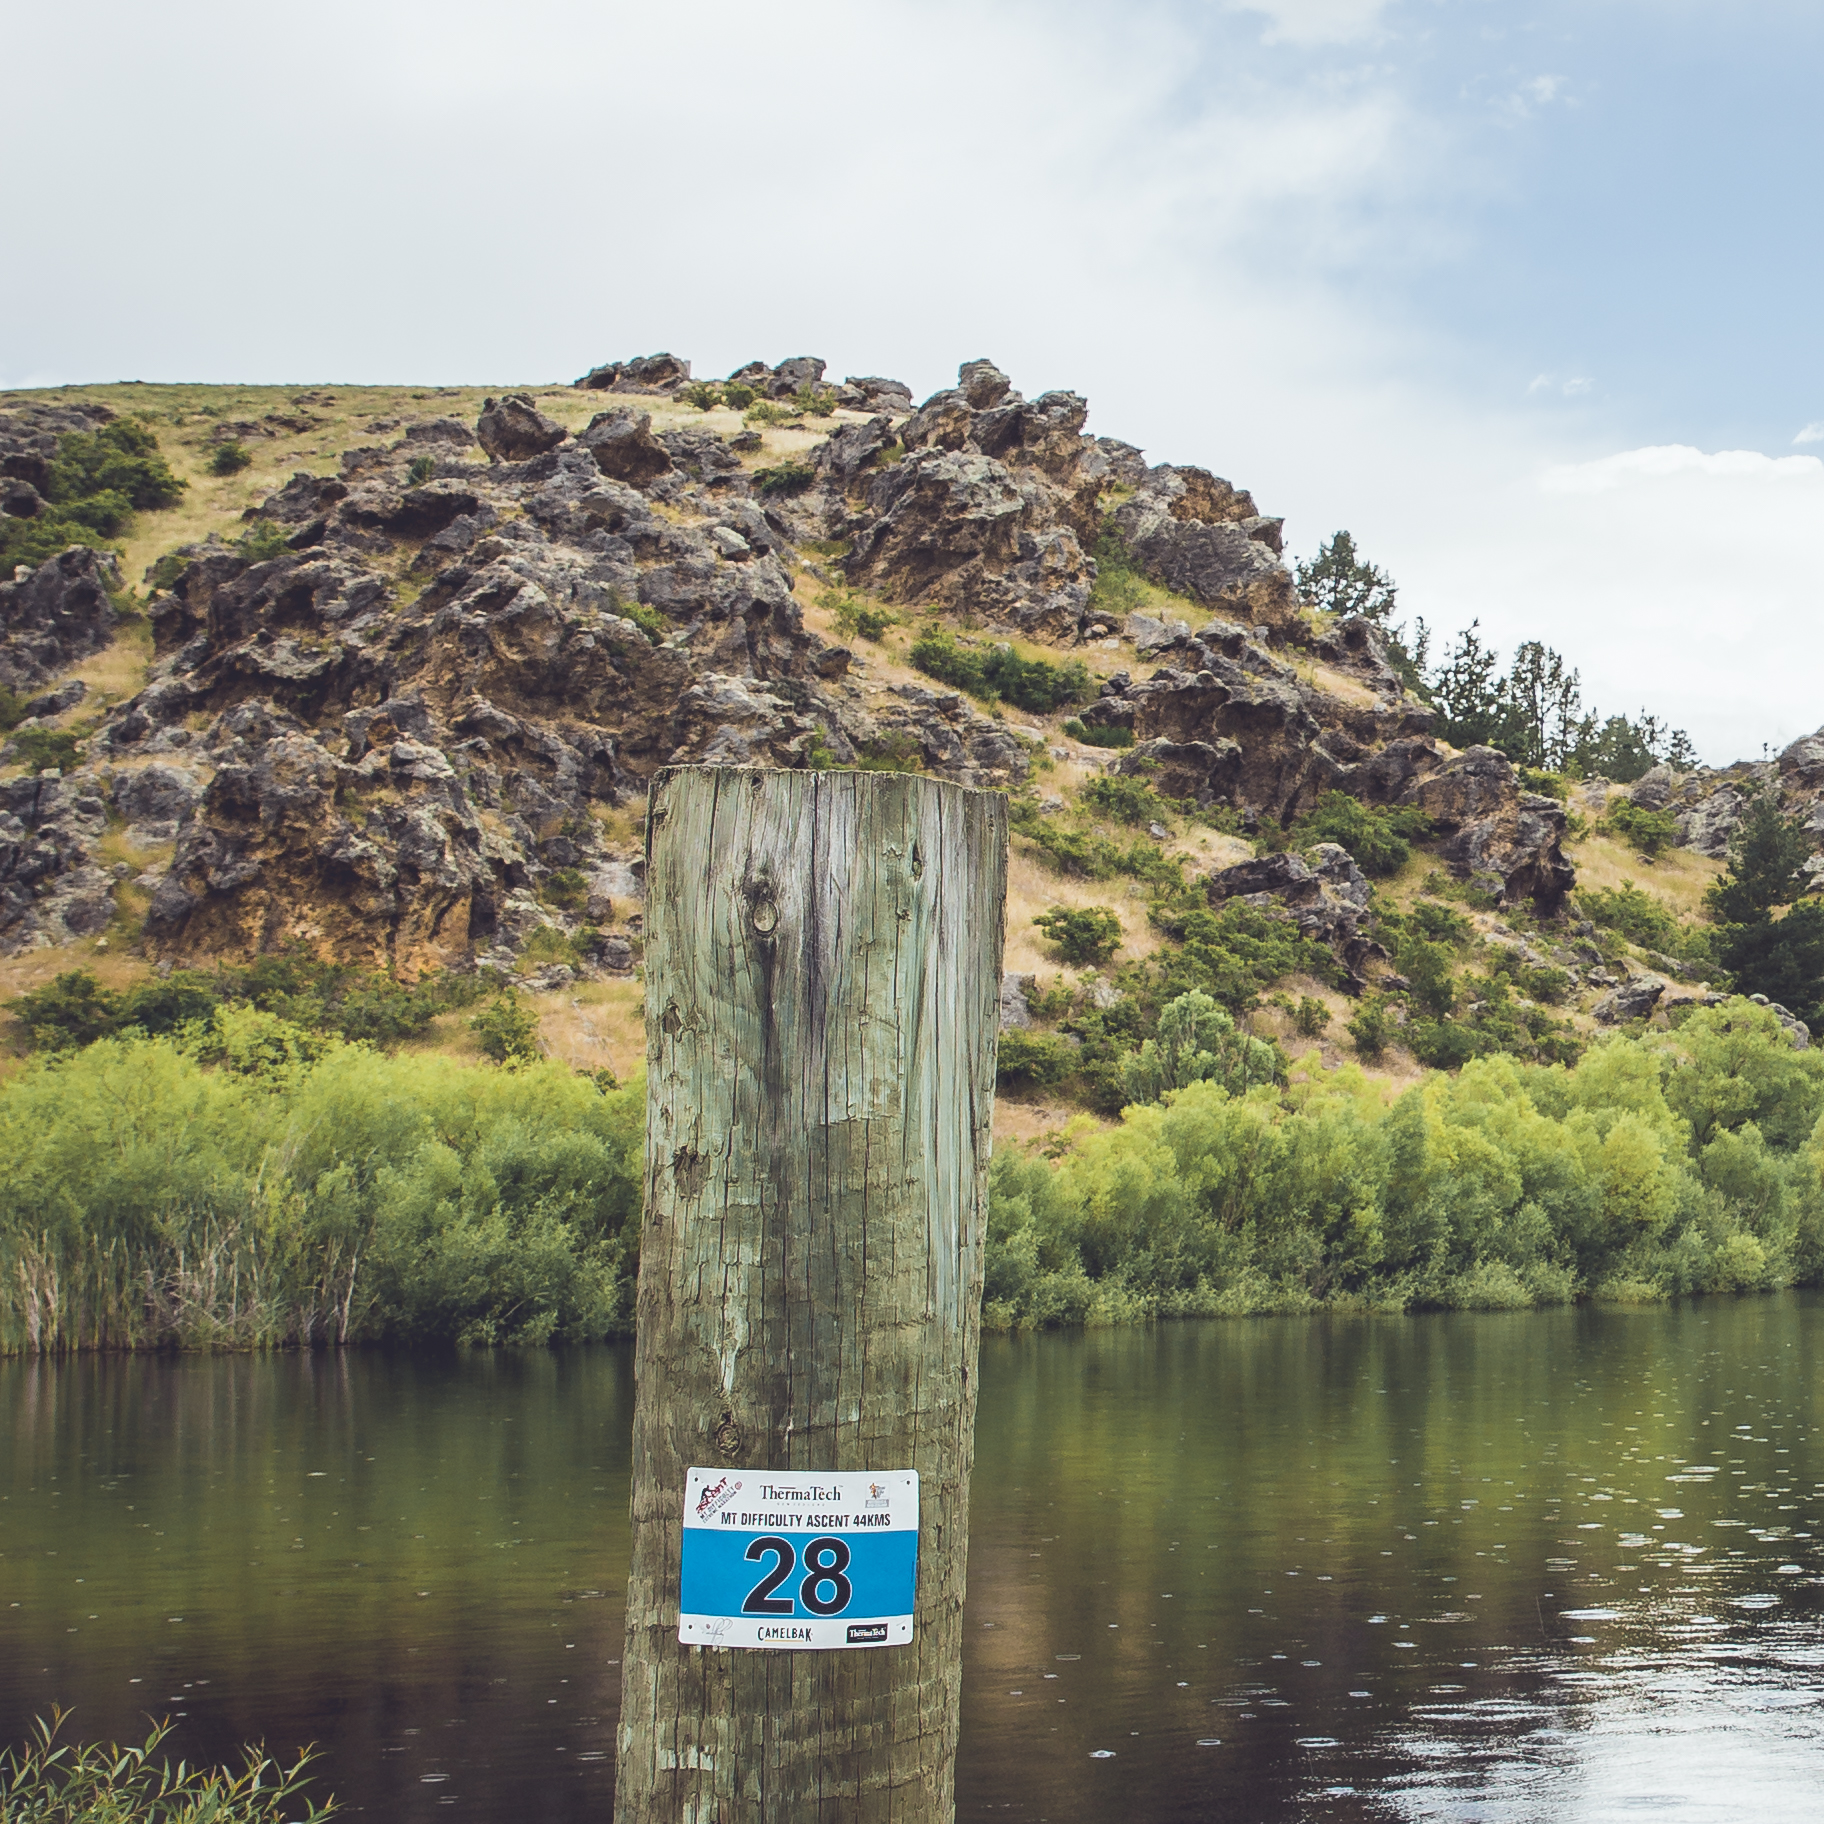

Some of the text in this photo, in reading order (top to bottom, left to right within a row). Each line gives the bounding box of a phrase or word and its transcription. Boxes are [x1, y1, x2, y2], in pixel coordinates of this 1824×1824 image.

[759, 1484, 841, 1501] ThermaTech
[721, 1511, 891, 1528] MT DIFFICULTY ASCENT 44KMS
[741, 1535, 853, 1616] 28
[757, 1626, 812, 1642] CAMELBAK
